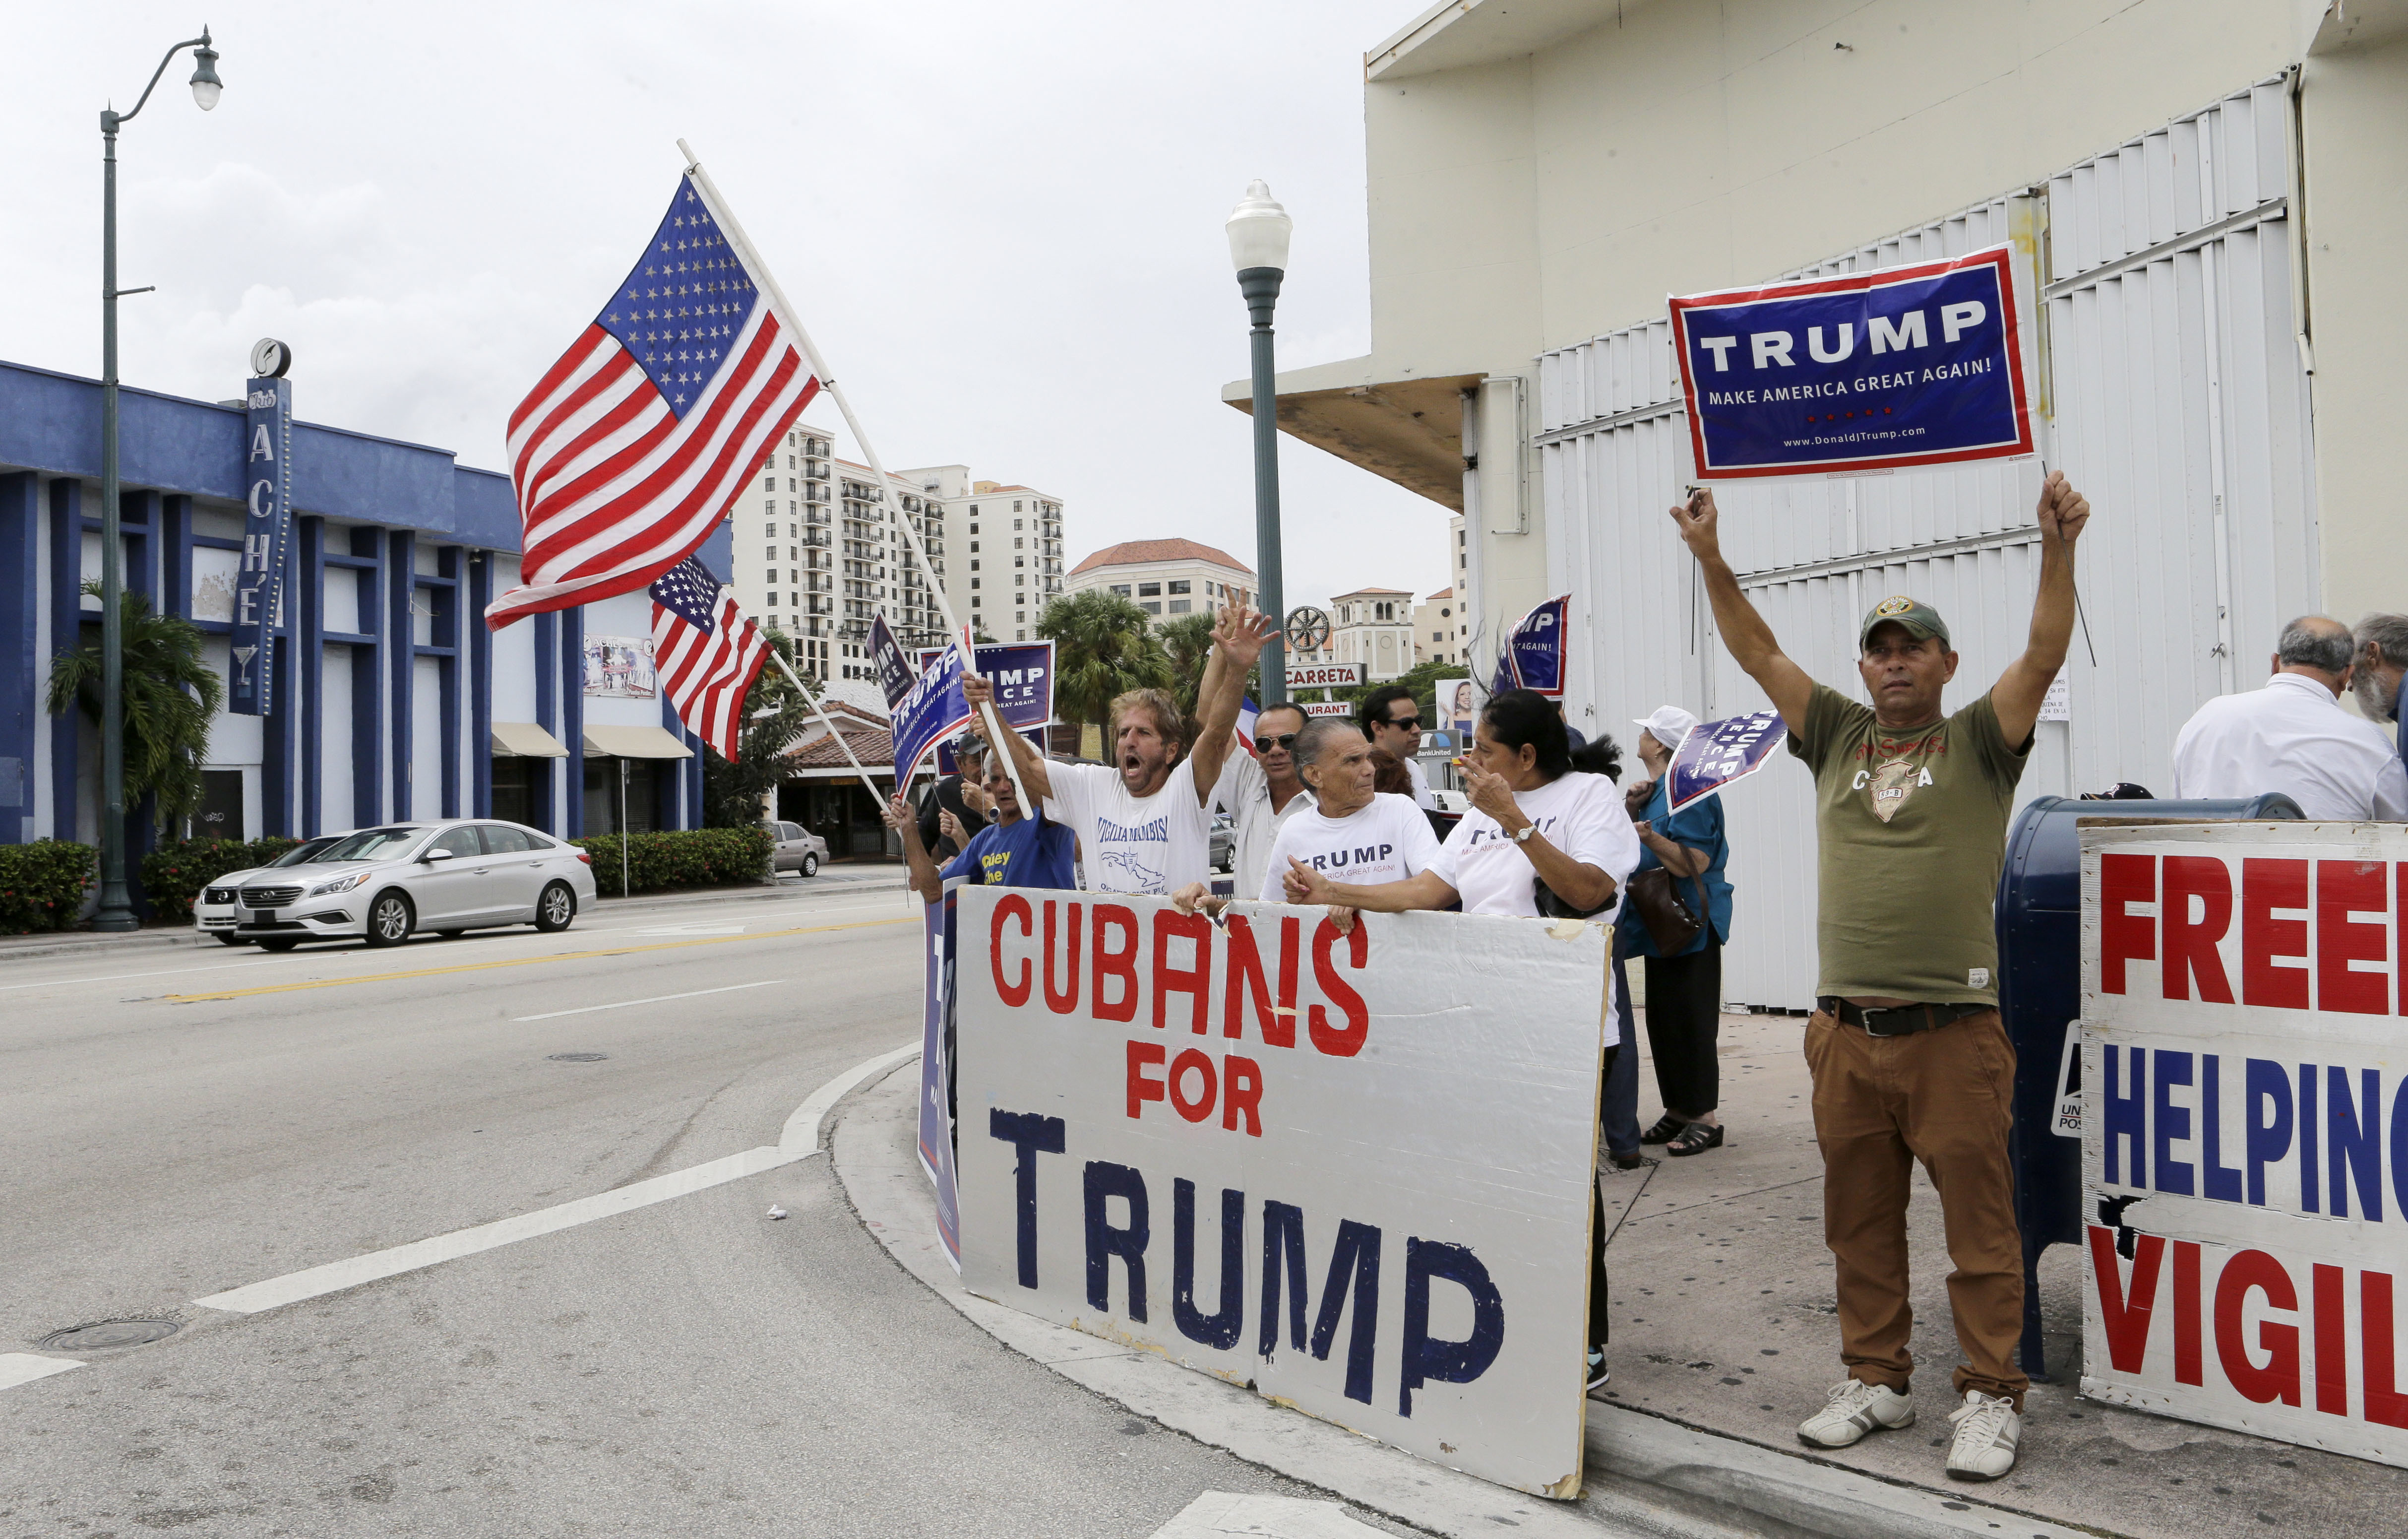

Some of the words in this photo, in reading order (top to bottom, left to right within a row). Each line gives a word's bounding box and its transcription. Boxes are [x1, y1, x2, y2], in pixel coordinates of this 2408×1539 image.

[1700, 301, 1986, 372] TRUMP
[1710, 389, 1757, 405] MAKE
[1763, 381, 1848, 402] AMERICA
[1854, 371, 1915, 392] GREAT
[1922, 358, 1991, 382] AGAIN!
[1784, 427, 1926, 447] www.DonaldJTrump.com
[1286, 668, 1356, 684] CARRETA
[1521, 642, 1551, 651] AGAIN!
[893, 649, 958, 738] TRUMP
[921, 696, 937, 715] GREAT
[937, 676, 960, 699] AGAIN!
[1308, 705, 1347, 714] URANT
[1703, 713, 1753, 773] PENCE
[1718, 708, 1779, 776] TRUMP
[1347, 867, 1370, 877] GREAT
[2100, 853, 2408, 1018] FREE
[990, 893, 1369, 1058] CUBANS
[1126, 1039, 1263, 1137] FOR
[989, 1107, 1505, 1418] TRUMP
